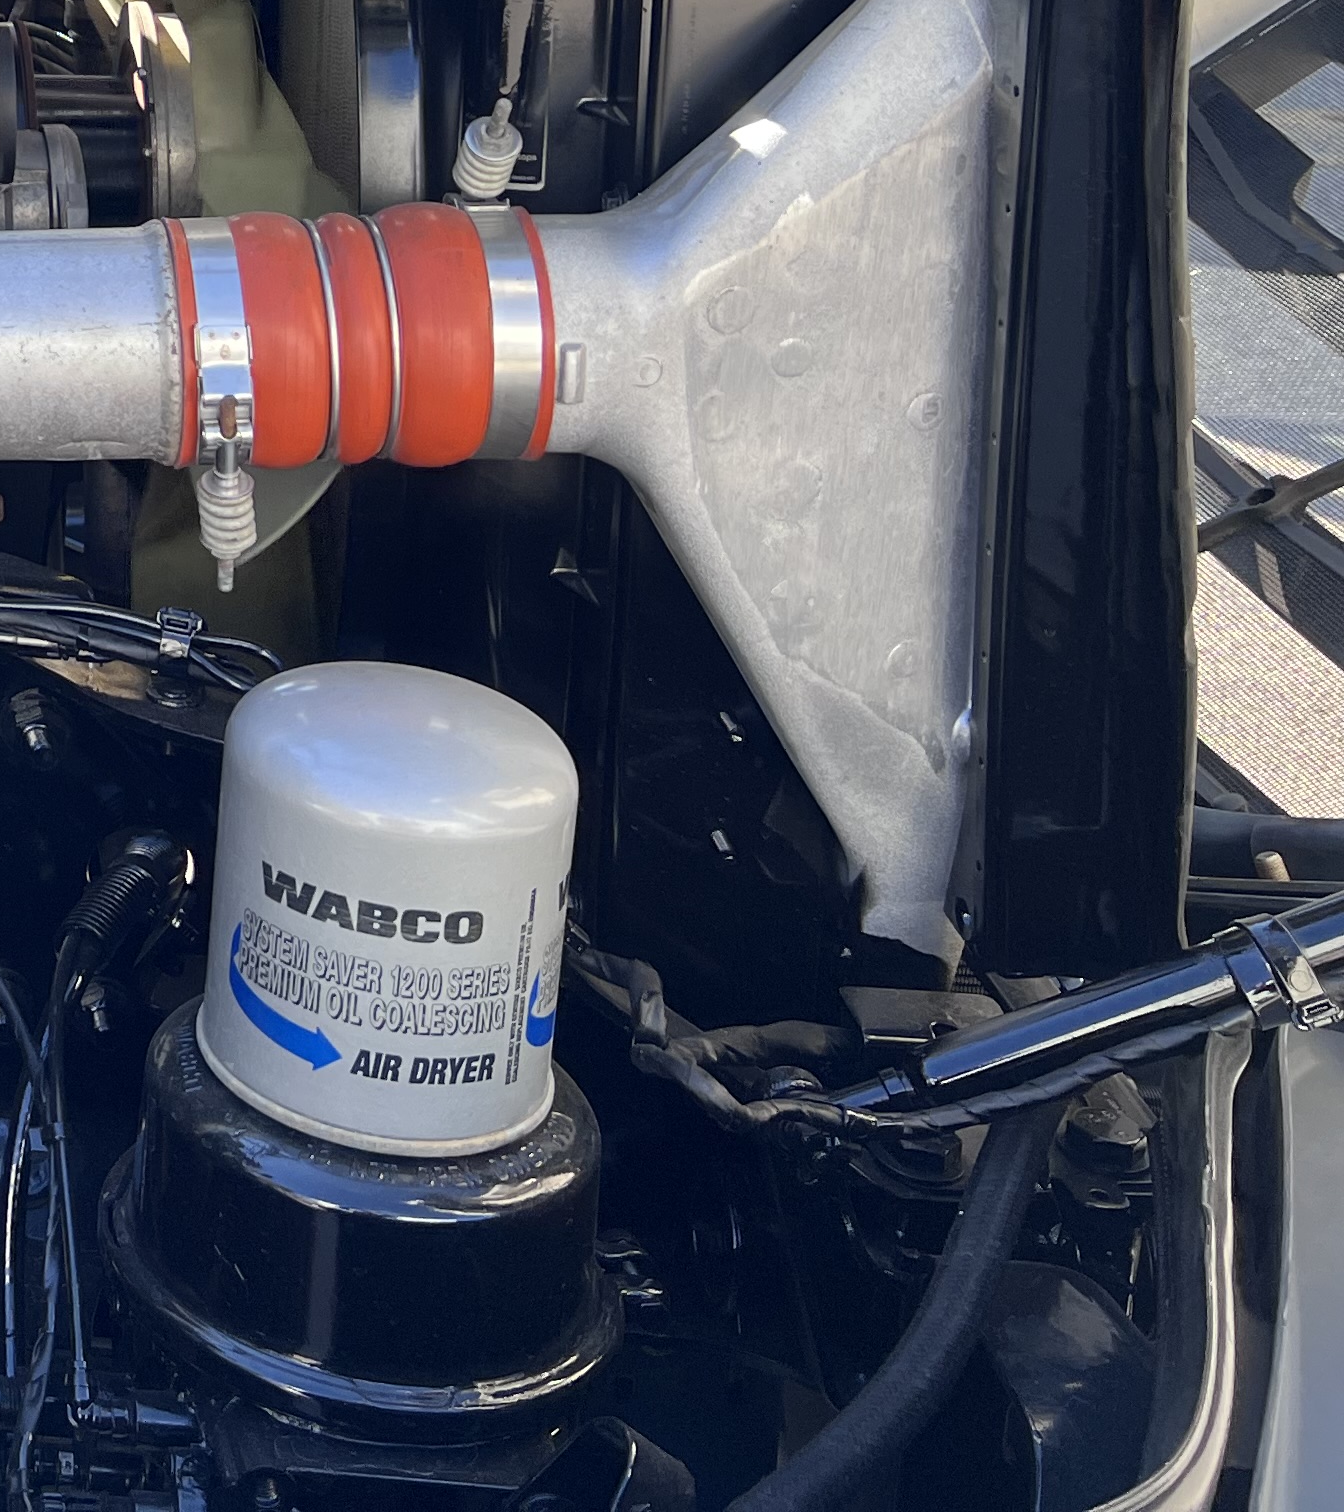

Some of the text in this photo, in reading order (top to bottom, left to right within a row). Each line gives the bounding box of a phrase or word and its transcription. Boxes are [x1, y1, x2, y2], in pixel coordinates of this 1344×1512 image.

[261, 860, 484, 945] WABCO
[238, 946, 507, 1037] PREMIUM OIL COALESCING
[242, 908, 313, 974] SYSTEM
[313, 945, 383, 995] SAVER
[391, 965, 443, 1000] 1200
[447, 962, 512, 1001] SERIES
[349, 1048, 496, 1087] AIR DRYER
